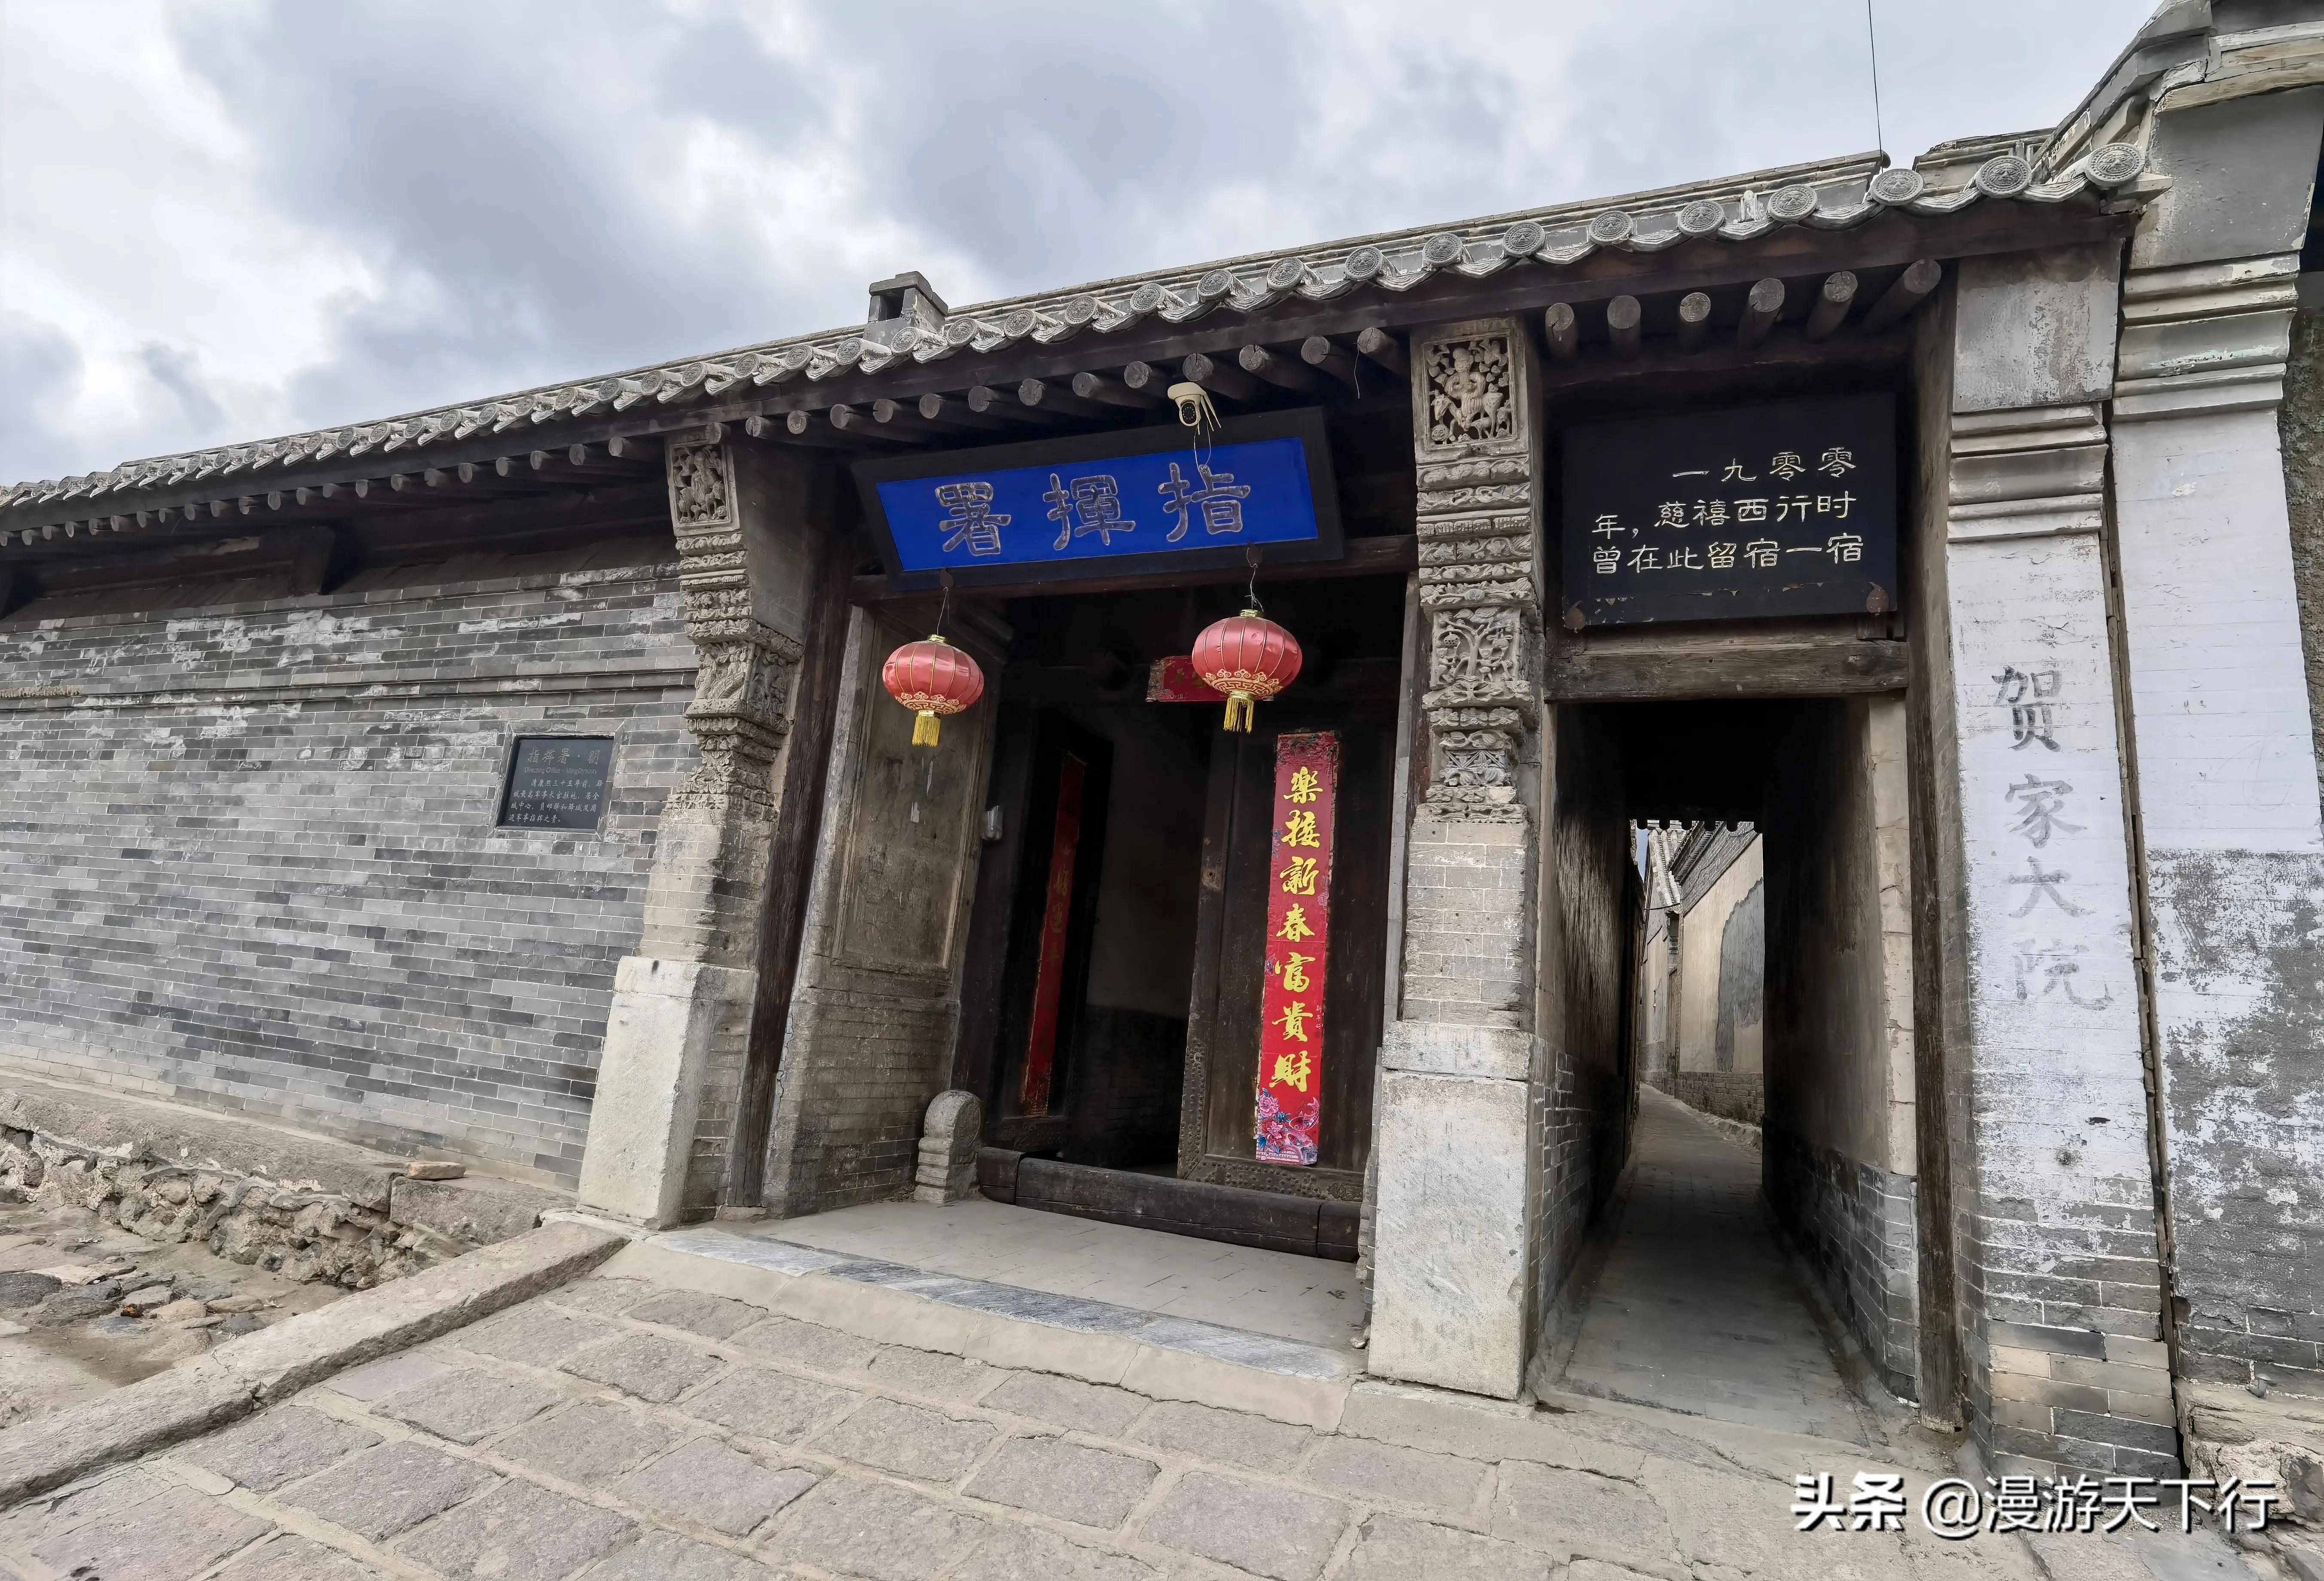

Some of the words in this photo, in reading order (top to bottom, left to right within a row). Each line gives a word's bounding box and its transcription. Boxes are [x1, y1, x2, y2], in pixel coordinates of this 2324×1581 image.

[1673, 447, 1856, 482] 一九零零
[1593, 532, 1864, 574] 曾在此留宿一宿
[1991, 664, 2114, 1012] 贺家大院
